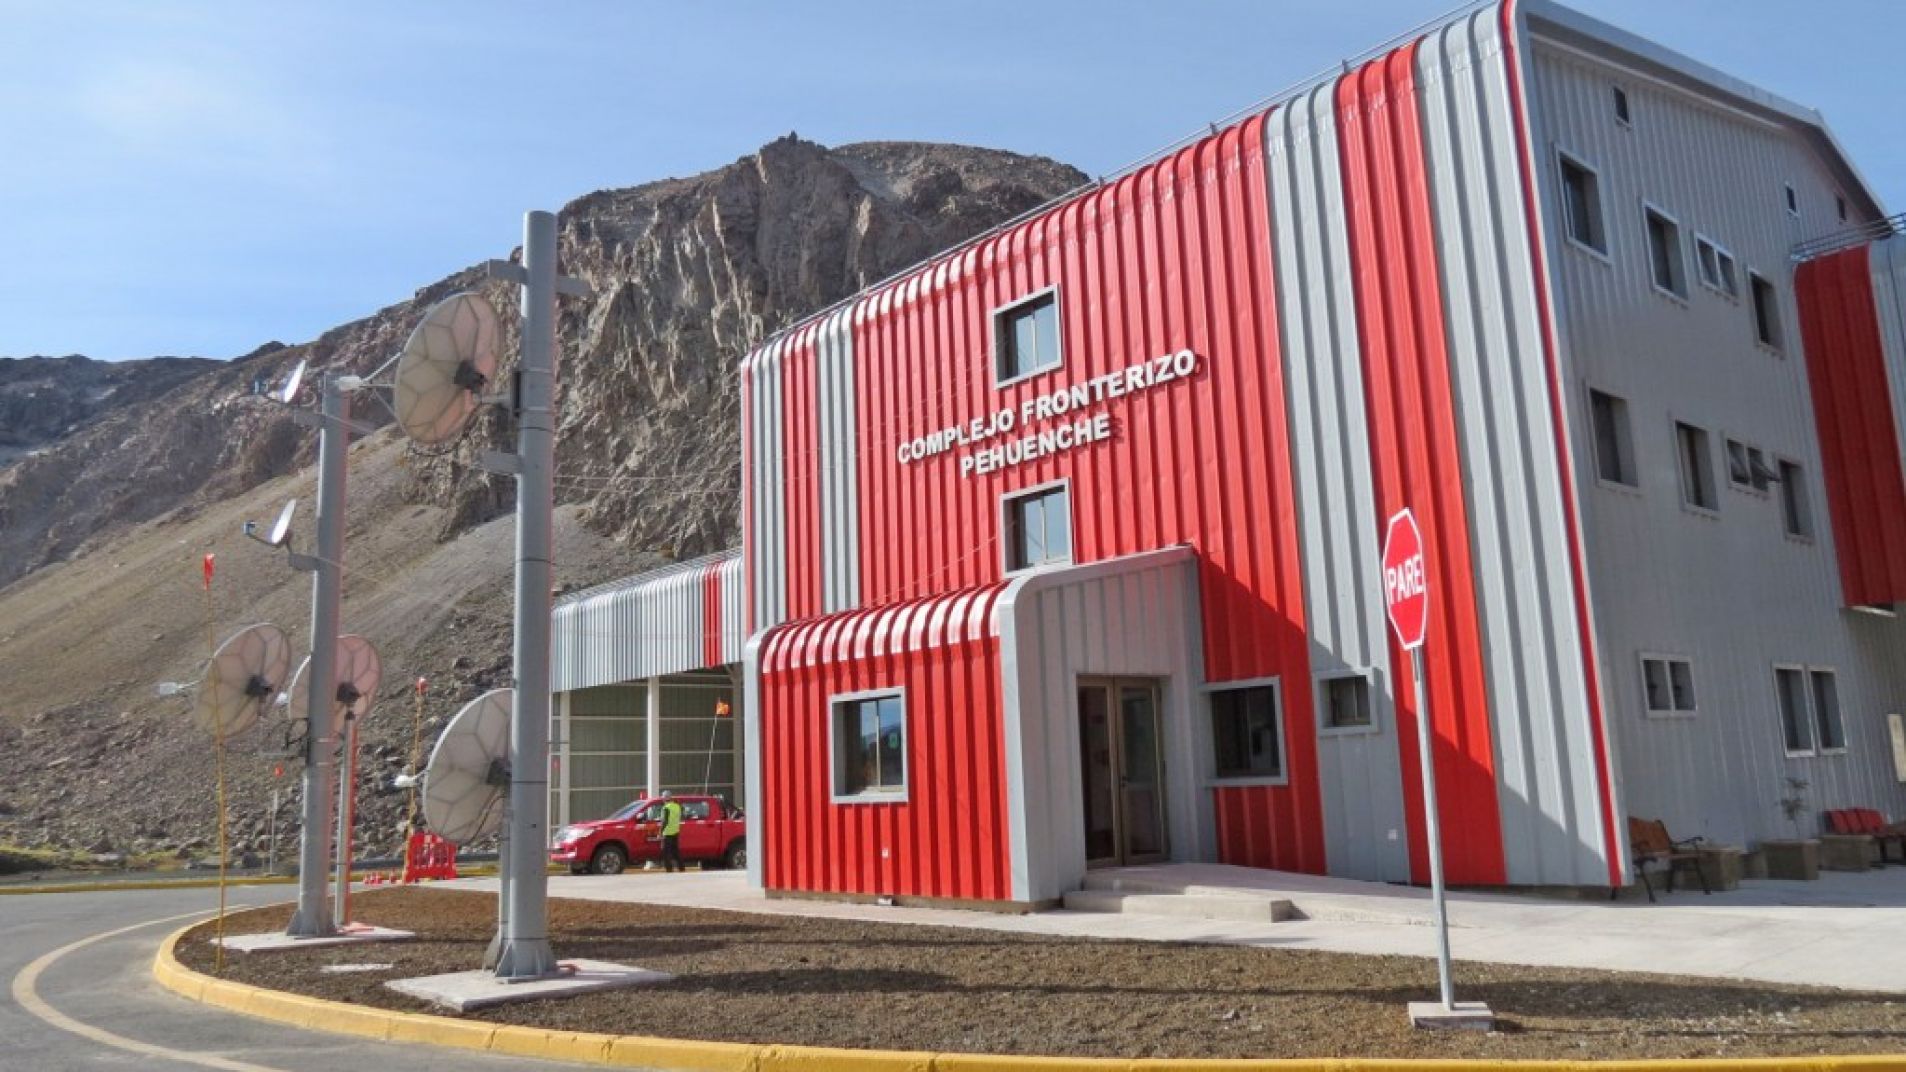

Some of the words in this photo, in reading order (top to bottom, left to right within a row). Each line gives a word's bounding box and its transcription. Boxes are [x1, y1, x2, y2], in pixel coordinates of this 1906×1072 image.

[897, 408, 1015, 464] COMPLEJO
[1021, 348, 1196, 425] FRONTERIZO
[960, 412, 1111, 478] PEHUENCHE
[1387, 554, 1424, 604] PARE
